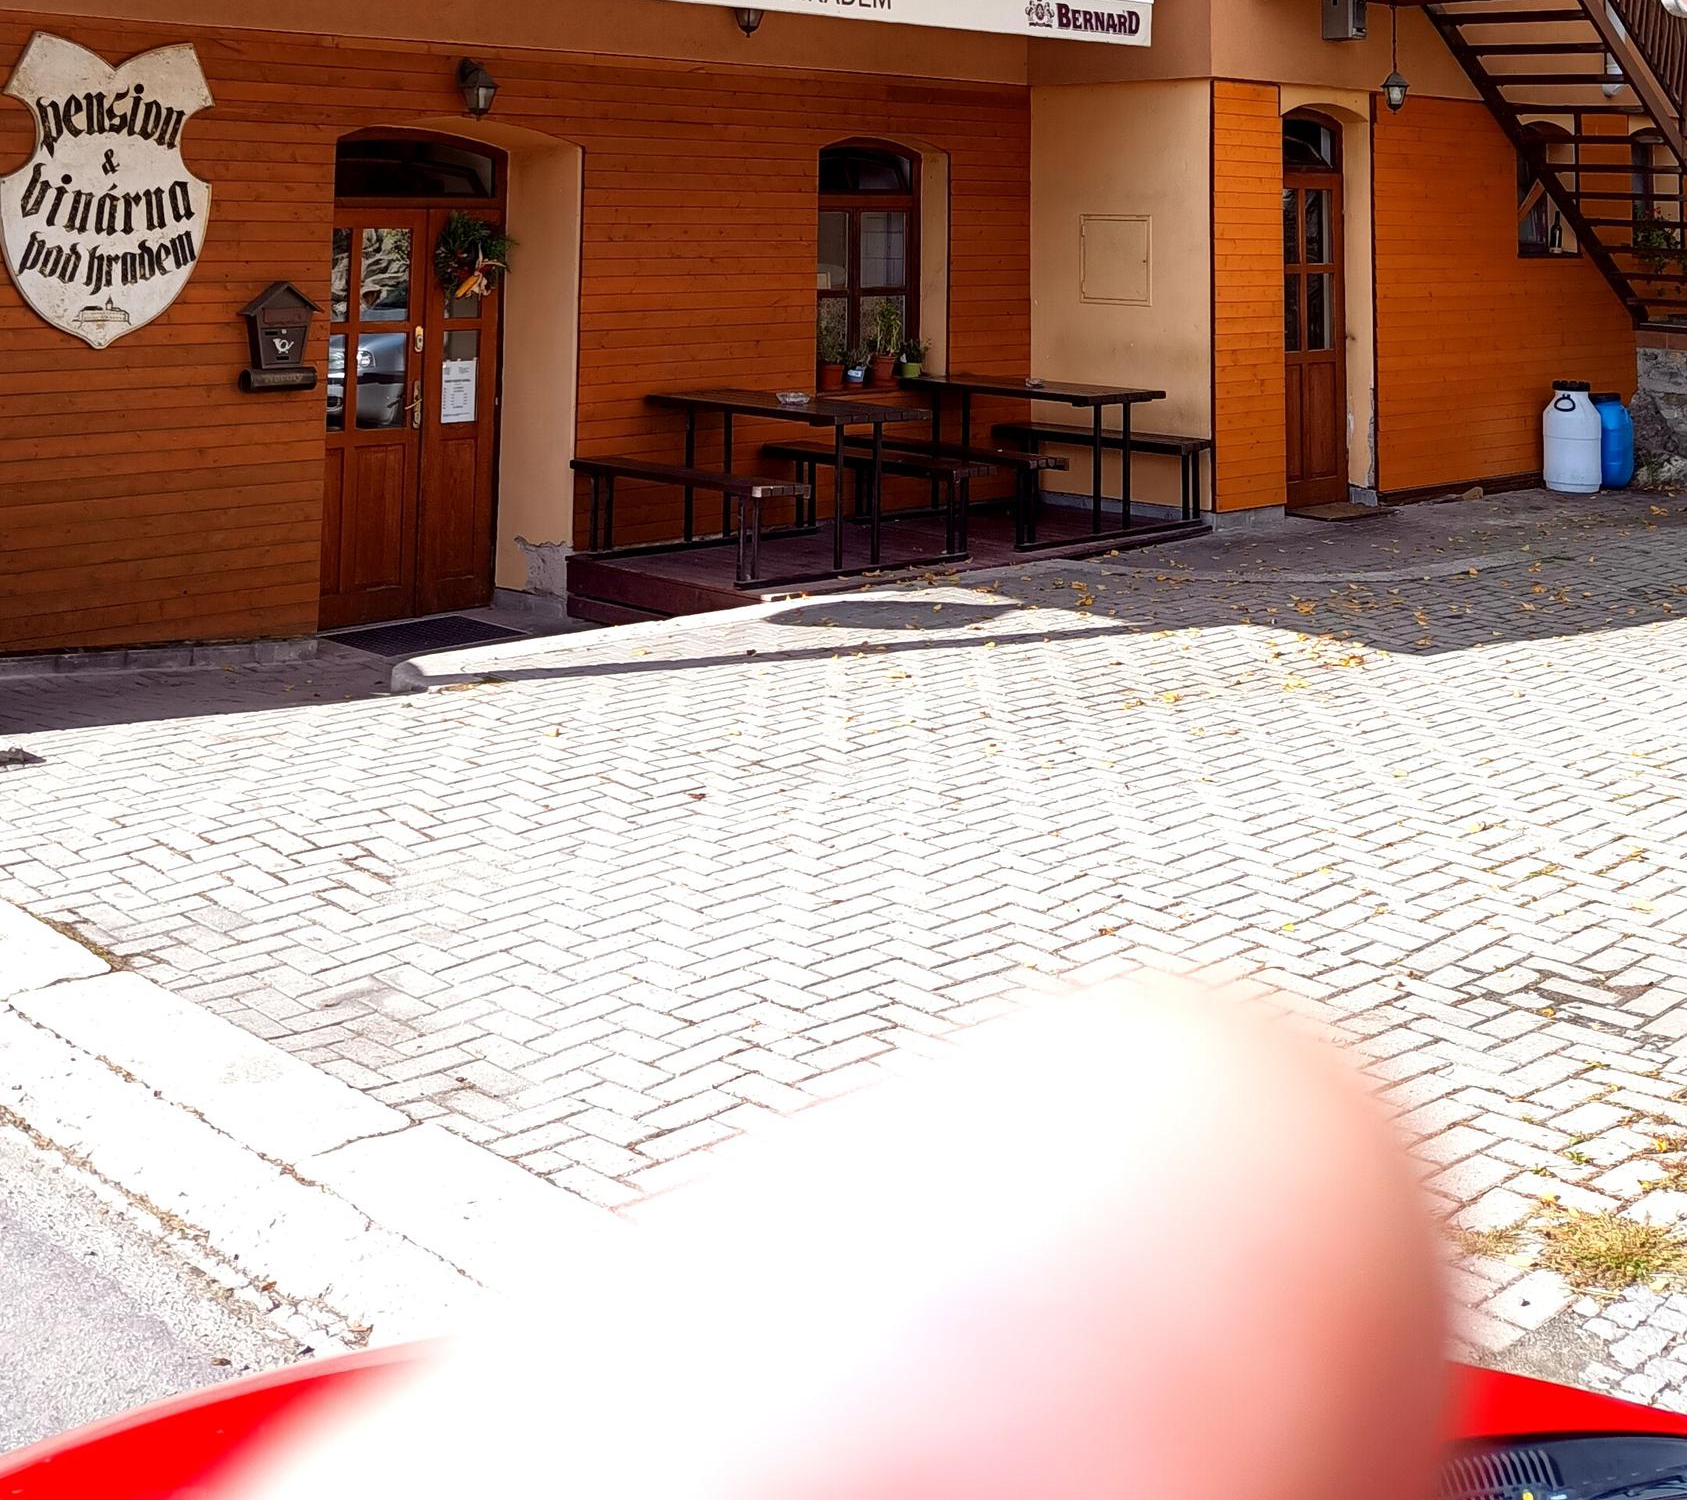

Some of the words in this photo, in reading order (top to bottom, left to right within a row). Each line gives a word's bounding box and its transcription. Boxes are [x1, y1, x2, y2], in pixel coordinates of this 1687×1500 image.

[1056, 2, 1141, 36] BERNARD
[36, 83, 186, 158] pension
[101, 148, 121, 176] &
[16, 230, 82, 284] pod
[82, 230, 197, 296] hradem
